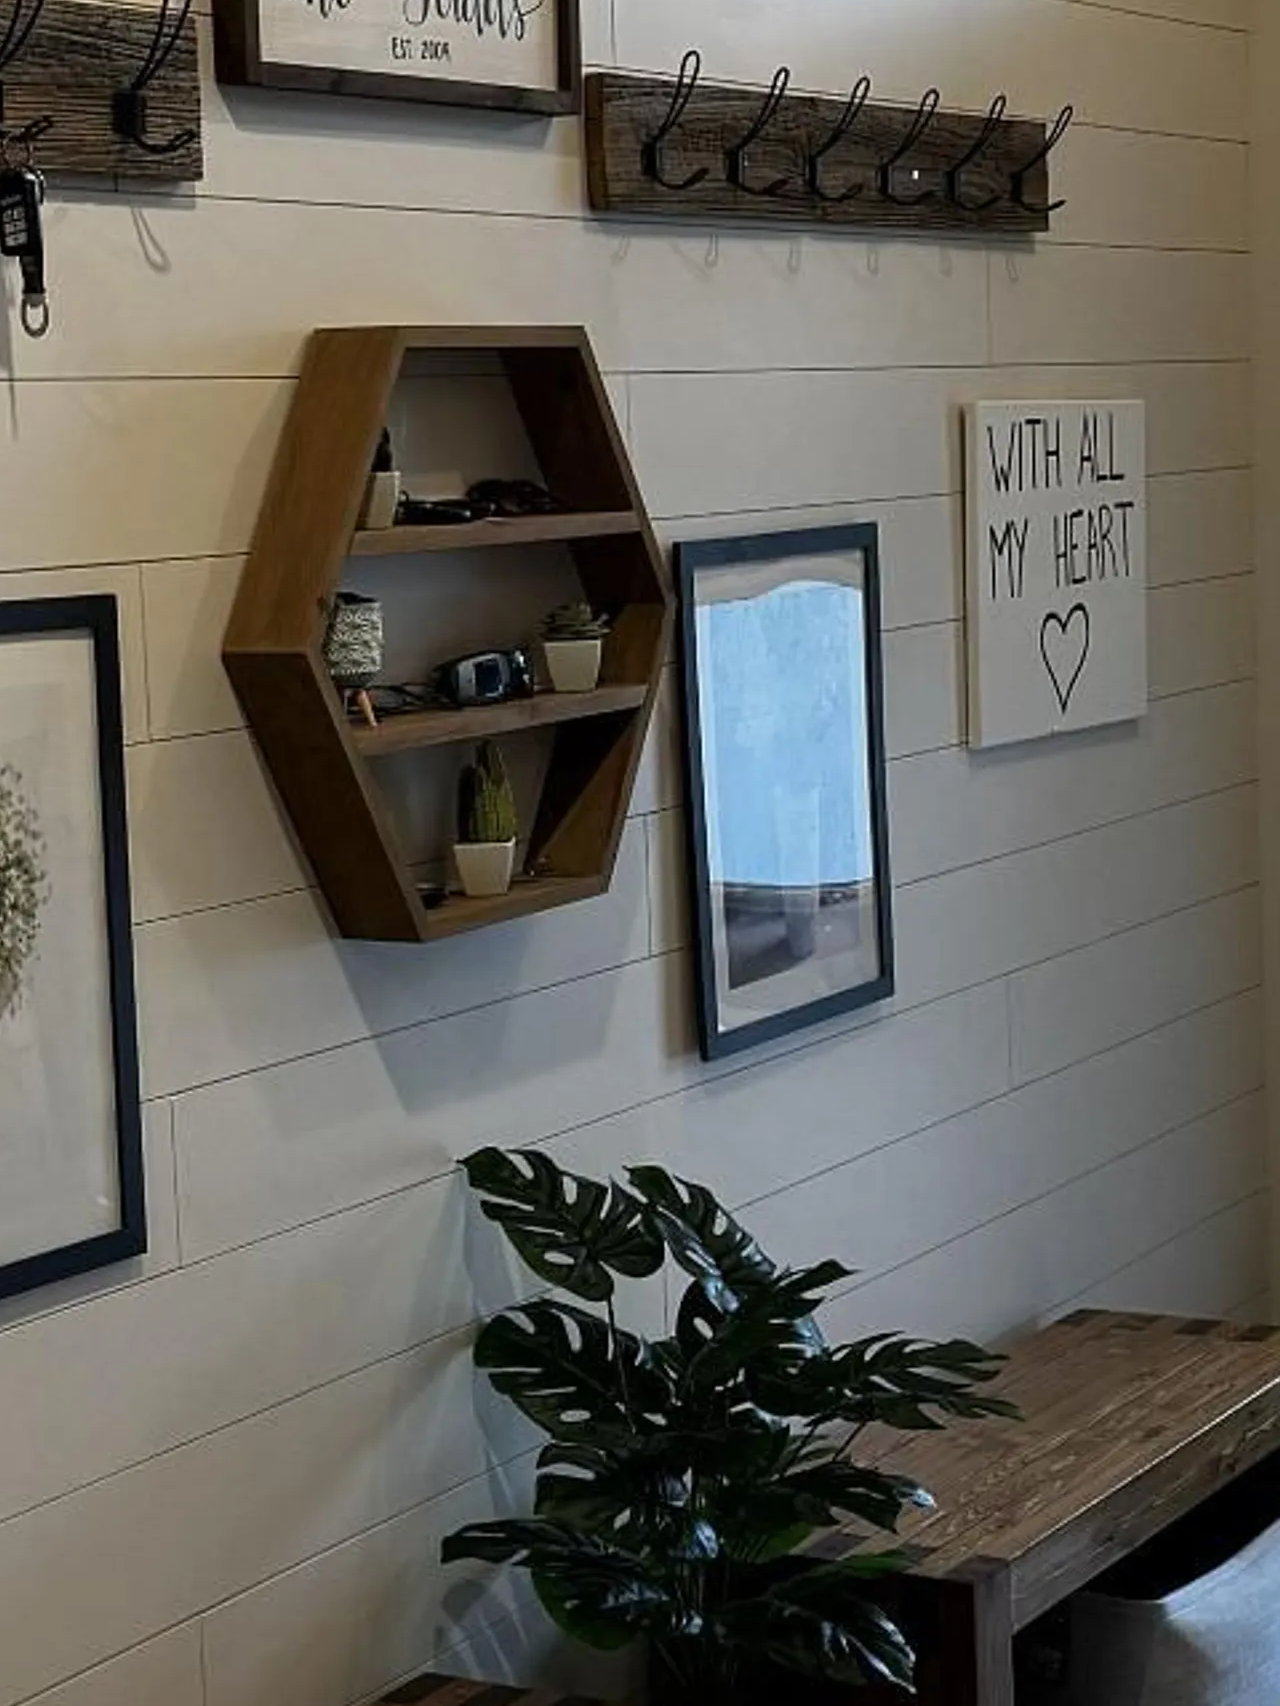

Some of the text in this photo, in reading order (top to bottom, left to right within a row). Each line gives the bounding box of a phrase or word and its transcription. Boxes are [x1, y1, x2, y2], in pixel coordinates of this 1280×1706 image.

[987, 411, 1125, 492] WITH ALL
[988, 501, 1135, 600] MY HEART
